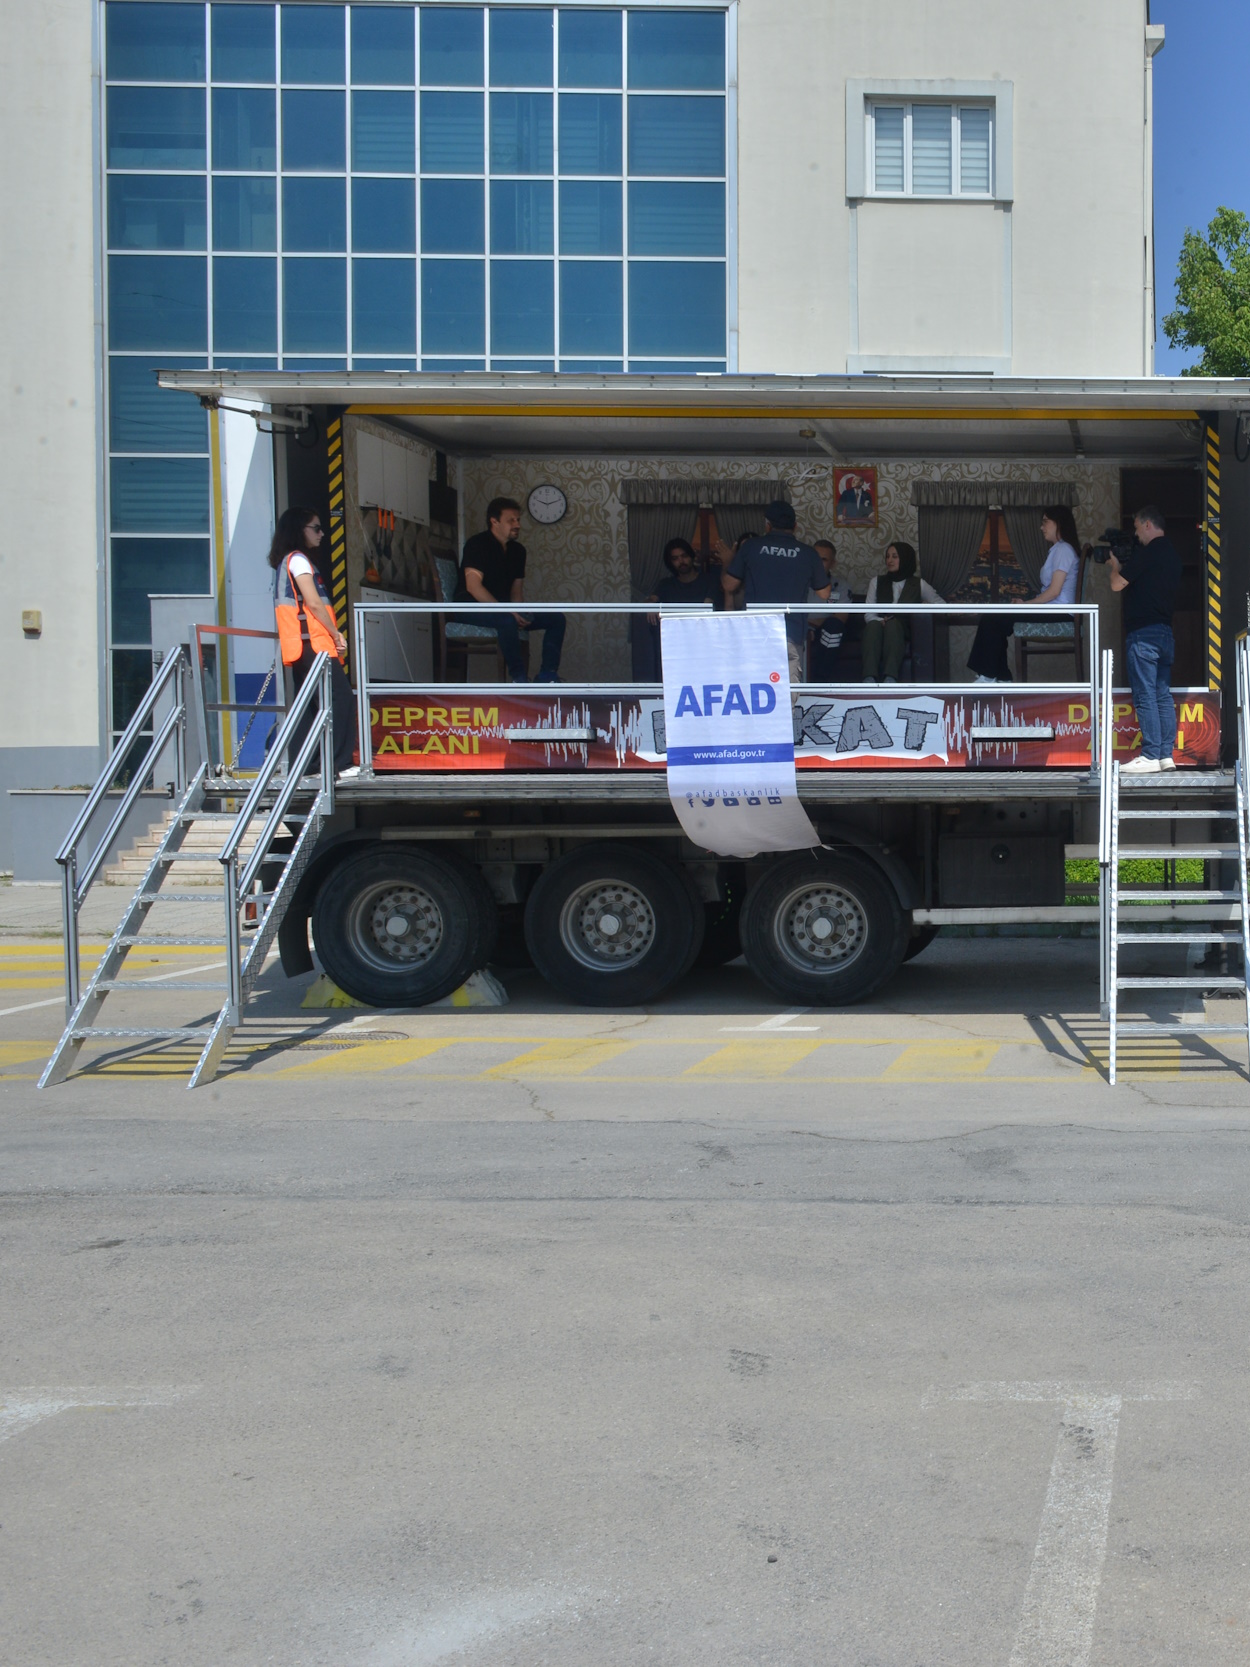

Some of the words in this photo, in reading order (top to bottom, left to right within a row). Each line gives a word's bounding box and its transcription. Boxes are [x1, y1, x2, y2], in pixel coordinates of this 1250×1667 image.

[760, 545, 800, 558] AFAD
[674, 682, 777, 718] AFAD
[377, 735, 479, 755] ALANI
[693, 749, 766, 760] www.afad.gov.tr
[686, 788, 780, 799] @afadbaskanlik
